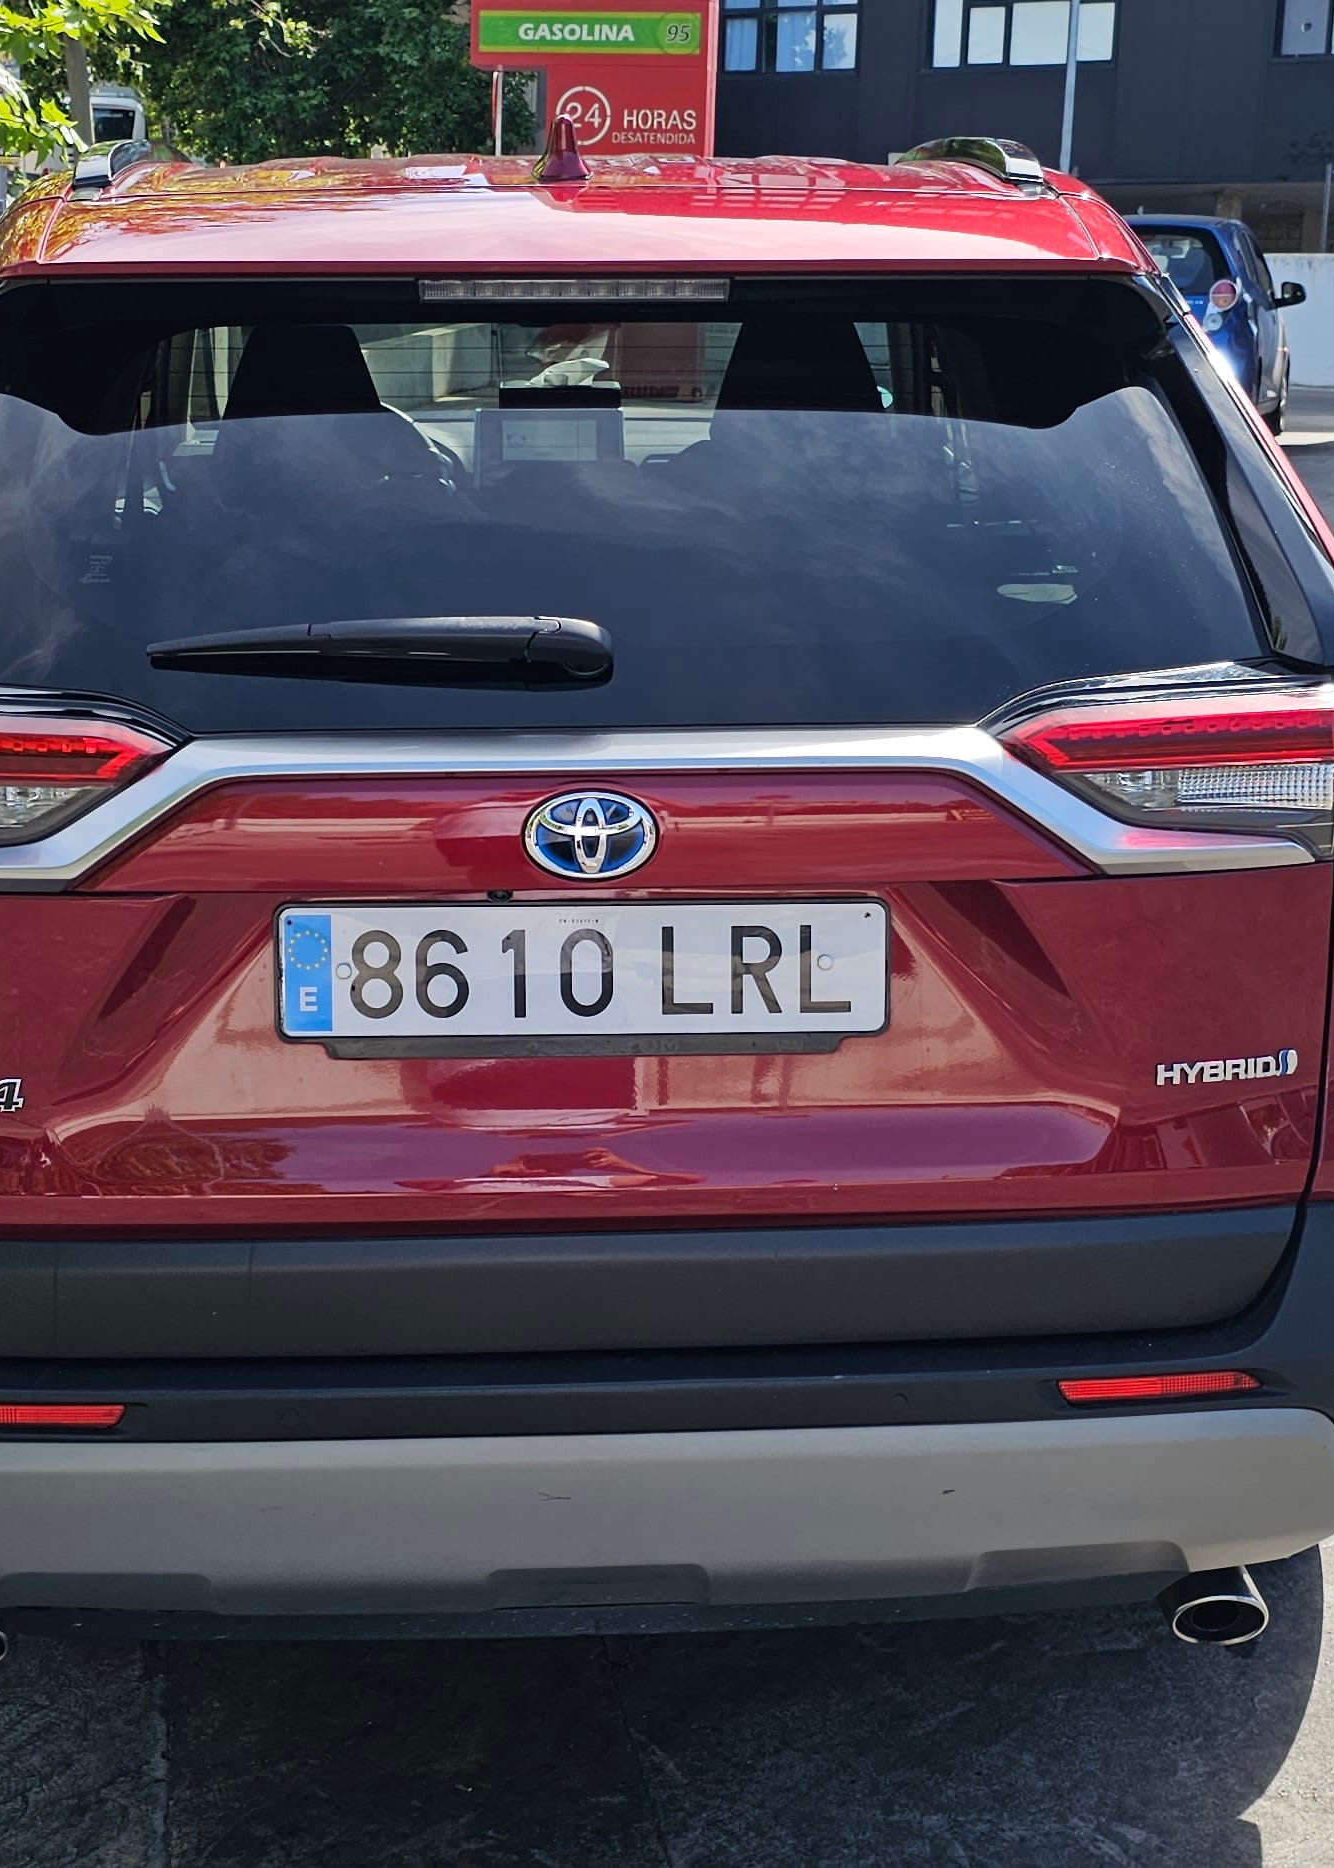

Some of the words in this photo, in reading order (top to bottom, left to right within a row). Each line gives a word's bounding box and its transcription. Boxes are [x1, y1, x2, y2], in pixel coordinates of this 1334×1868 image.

[519, 23, 635, 42] GASOLINA
[666, 24, 691, 42] 95
[623, 109, 697, 130] HORAS
[612, 132, 696, 145] DESATENDIDA
[350, 928, 615, 1019] 8610
[661, 924, 852, 1016] LRL
[298, 986, 319, 1012] E
[1156, 1056, 1278, 1086] HYBRID
